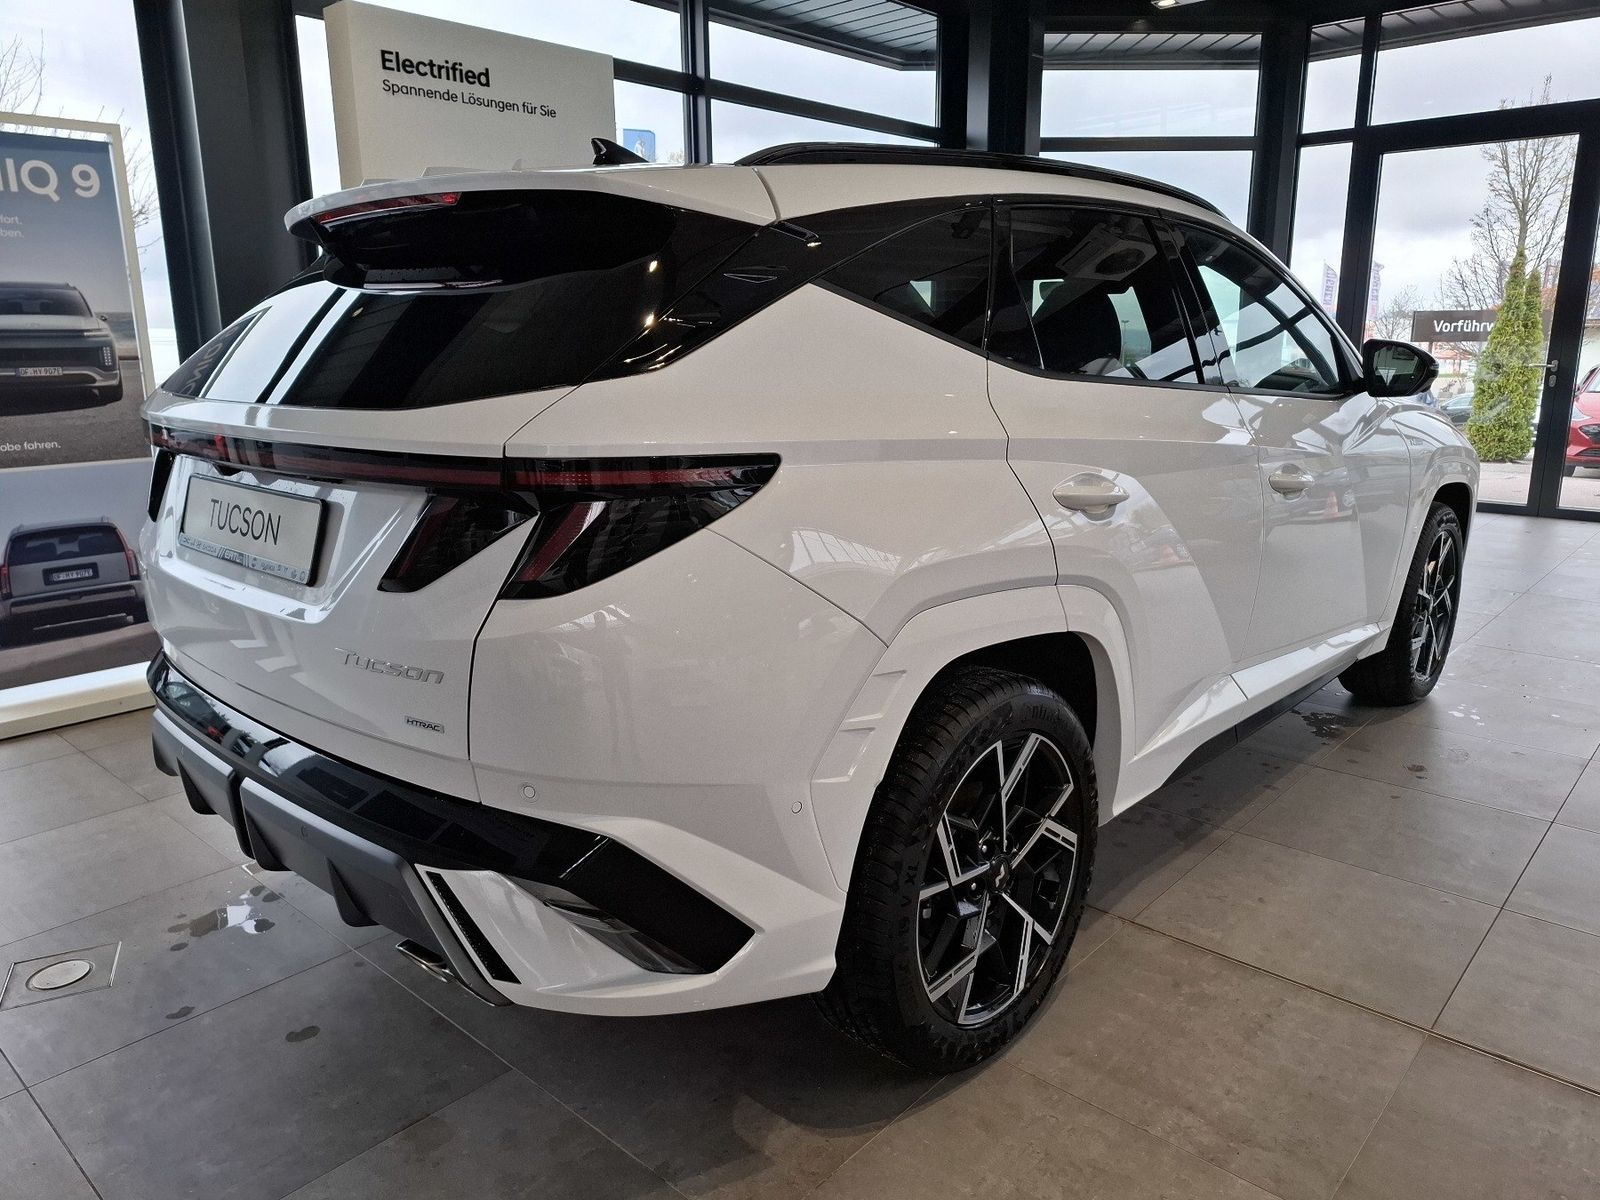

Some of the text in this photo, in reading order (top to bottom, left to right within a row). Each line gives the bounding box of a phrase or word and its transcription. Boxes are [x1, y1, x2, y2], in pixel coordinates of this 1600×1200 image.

[381, 49, 491, 88] Electrified
[382, 78, 557, 118] Spannende Lösungen für Sie
[71, 163, 101, 198] 9
[24, 441, 61, 451] fahren.
[210, 498, 281, 546] TUCSON
[405, 718, 441, 732] HTRAC
